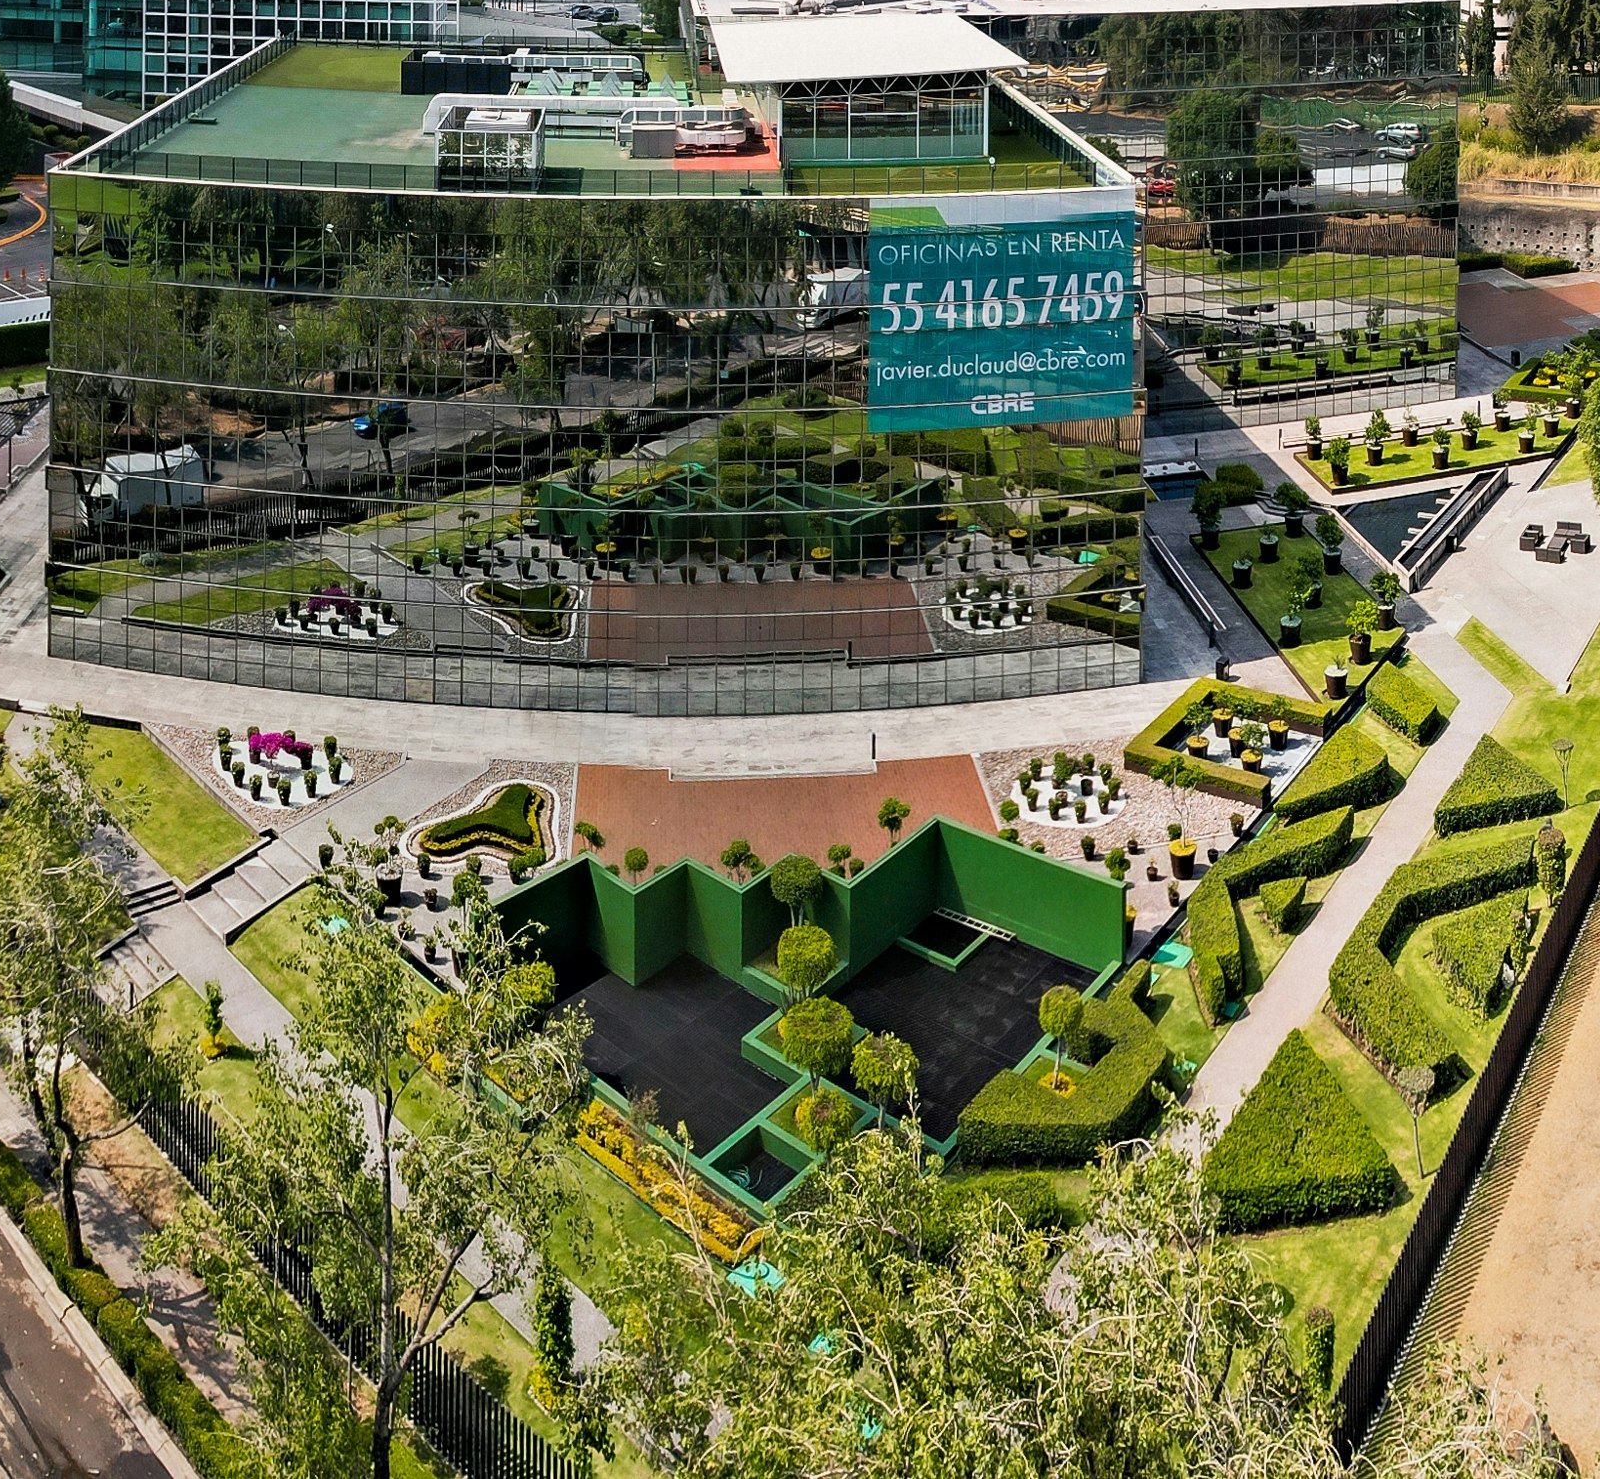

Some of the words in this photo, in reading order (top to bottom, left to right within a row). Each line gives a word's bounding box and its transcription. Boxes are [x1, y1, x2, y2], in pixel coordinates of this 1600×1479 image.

[1008, 234, 1040, 255] EN
[1051, 228, 1125, 253] RENTA
[880, 282, 924, 335] 55
[935, 277, 1026, 330] 4165
[1037, 270, 1125, 327] 7459
[876, 351, 1126, 386] javier.duclaud@cbre.com
[970, 391, 1036, 415] CBRE
